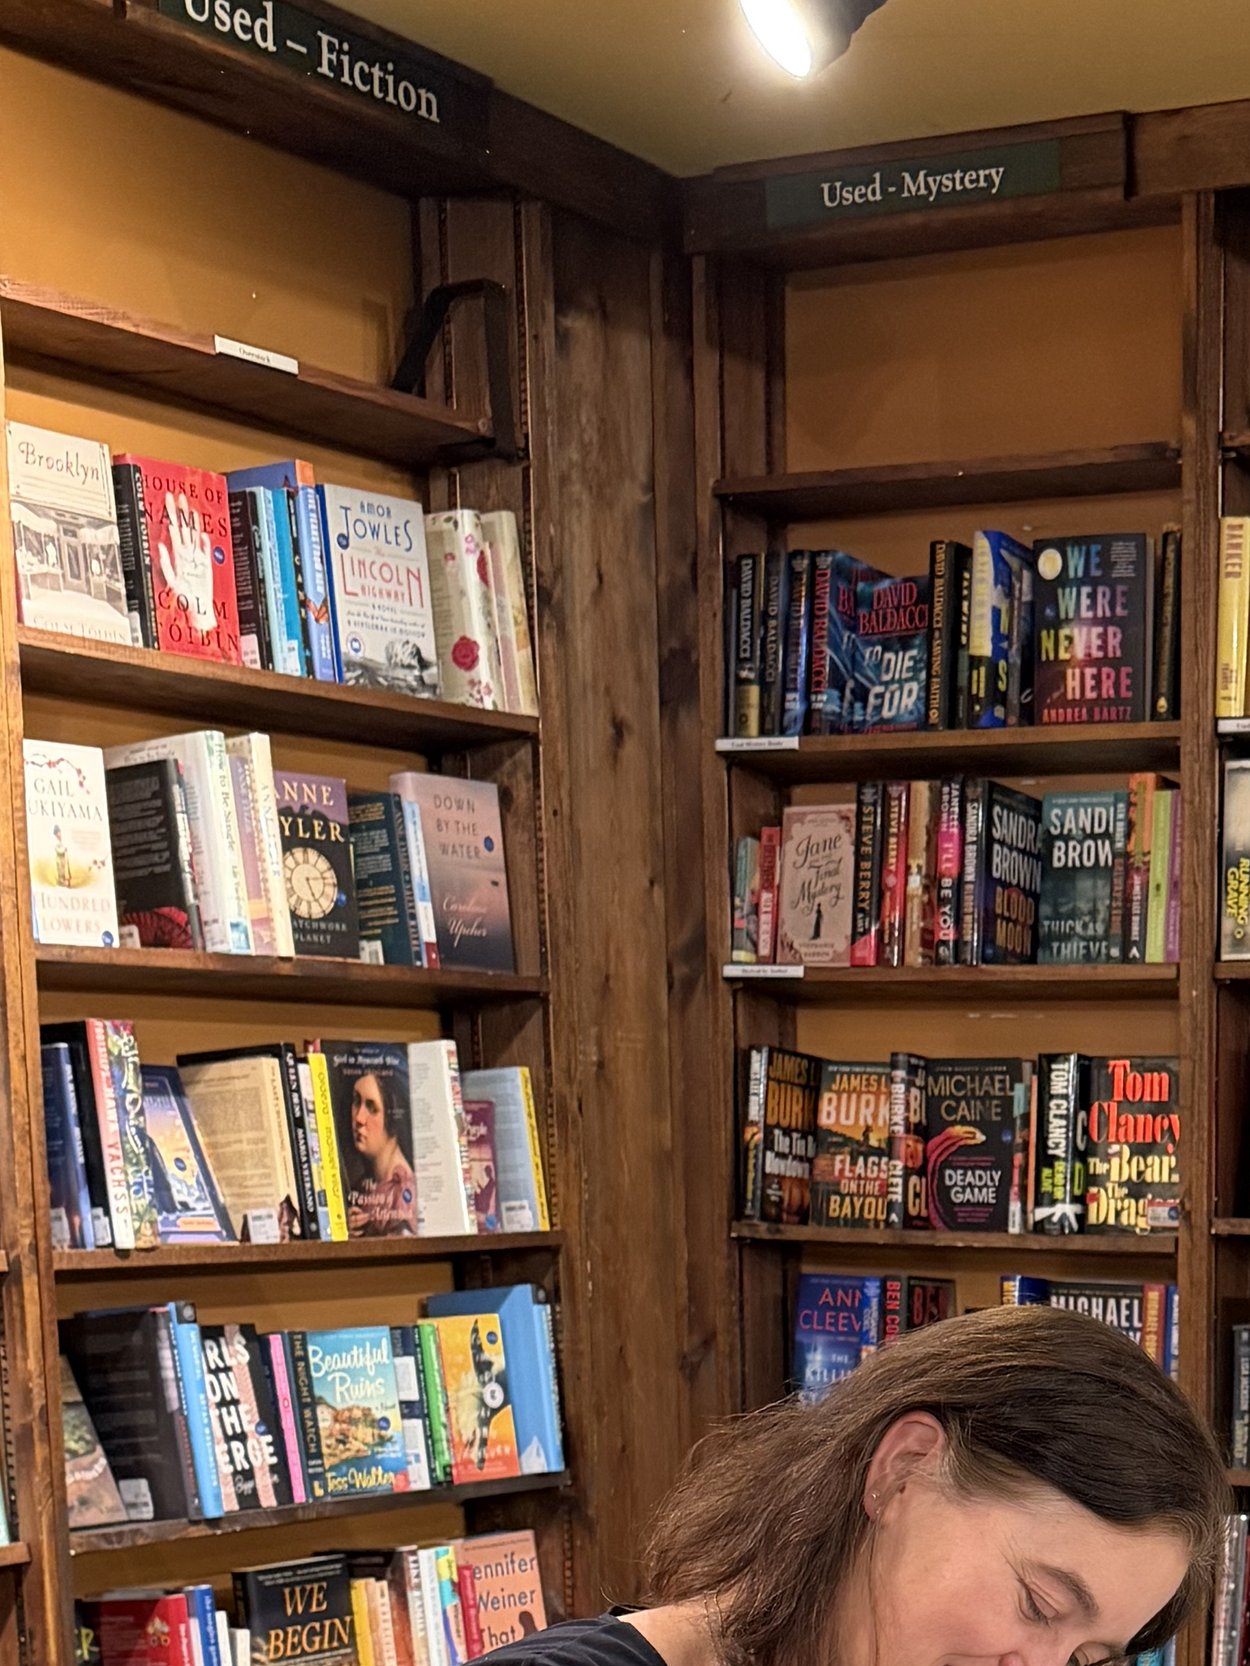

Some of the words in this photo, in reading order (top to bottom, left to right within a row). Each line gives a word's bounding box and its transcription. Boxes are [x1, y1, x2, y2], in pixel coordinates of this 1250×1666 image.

[317, 30, 440, 123] Fiction
[821, 171, 882, 207] Used
[901, 166, 1005, 202] Mystery
[18, 441, 100, 485] Brooklyn
[204, 487, 225, 504] OF
[359, 501, 392, 517] AMOR
[337, 504, 413, 552] TOWLES
[1066, 543, 1102, 579] WE
[1223, 523, 1245, 580] BANKER
[340, 554, 425, 608] LINCOLN
[873, 581, 918, 609] DAVID
[159, 590, 228, 620] COLM
[859, 603, 929, 635] BALDACCI
[1057, 585, 1129, 620] WERE
[1040, 626, 1122, 662] NEVER
[863, 645, 883, 665] TO
[880, 649, 918, 682] DIE
[865, 681, 919, 721] FOR
[1066, 666, 1134, 701] HERE
[1042, 707, 1088, 723] ANDREA
[1093, 705, 1132, 722] BARTZ
[33, 777, 74, 798] GAIL
[432, 793, 476, 813] DOWN
[436, 818, 450, 833] BY
[454, 820, 478, 837] THE
[860, 805, 875, 855] STEVE
[991, 805, 1043, 855] SANDRA
[438, 842, 482, 859] WATER
[793, 833, 842, 869] Jane
[857, 861, 873, 911] BERRY
[991, 844, 1042, 894] BROWN
[792, 879, 844, 916] Mystery
[1226, 866, 1239, 919] GRAVE
[1236, 857, 1250, 925] RUNNING
[770, 1053, 808, 1083] JAMES
[832, 1074, 878, 1092] JAMES
[928, 1073, 1015, 1098] MICHAEL
[1050, 1062, 1069, 1095] TOM
[1108, 1059, 1169, 1102] Tom
[940, 1099, 1001, 1122] CAINE
[1089, 1101, 1181, 1154] Clancy
[1047, 1099, 1068, 1159] CLANCY
[834, 1154, 888, 1179] FLAGS
[944, 1169, 1002, 1187] DEADLY
[1087, 1156, 1109, 1175] The
[829, 1195, 887, 1220] BAYOU
[950, 1187, 997, 1204] GAME
[1106, 1182, 1129, 1199] The
[886, 1281, 901, 1310] BEN
[308, 1338, 390, 1378] Beautiful
[297, 1362, 312, 1404] NIGHT
[327, 1371, 386, 1403] Ruins
[304, 1408, 320, 1454] WATCH
[349, 1465, 396, 1490] Walter
[472, 1552, 536, 1581] ennifer
[283, 1581, 328, 1618] WE
[267, 1615, 353, 1661] BEGIN
